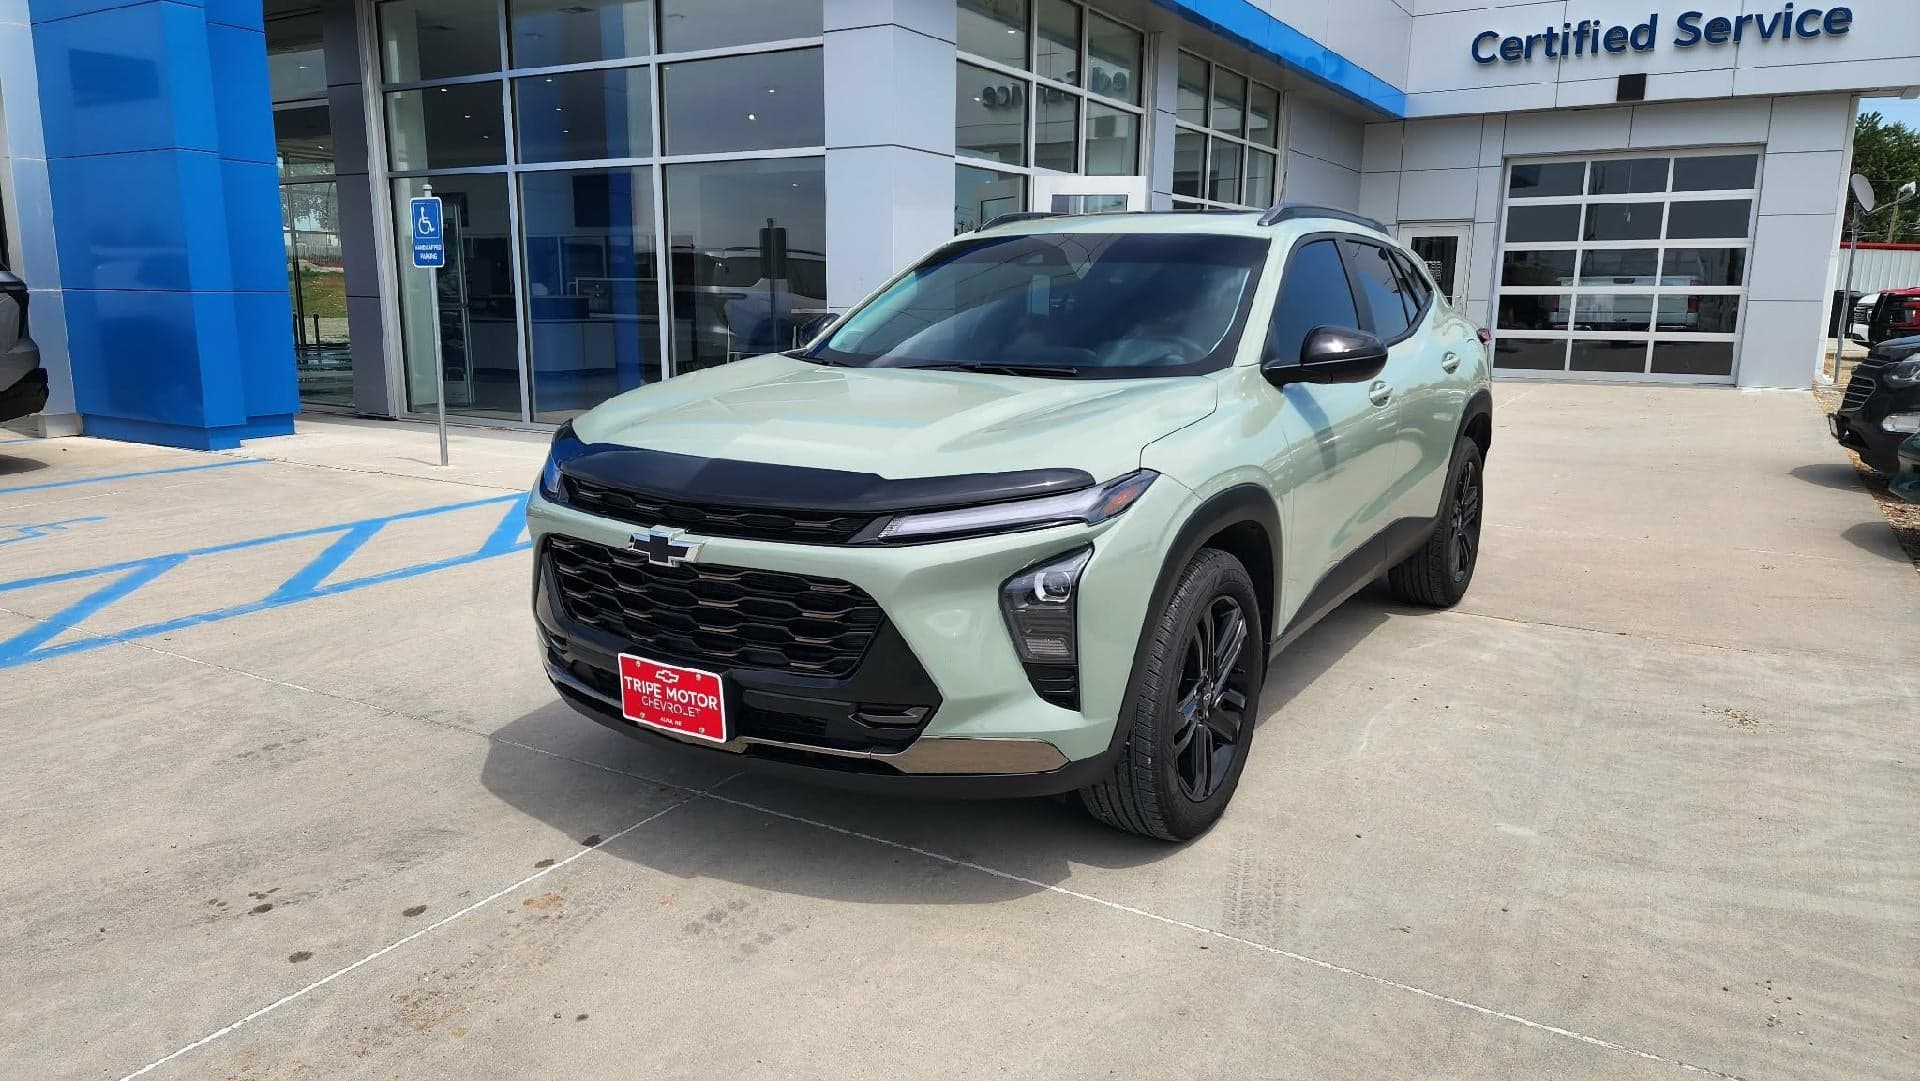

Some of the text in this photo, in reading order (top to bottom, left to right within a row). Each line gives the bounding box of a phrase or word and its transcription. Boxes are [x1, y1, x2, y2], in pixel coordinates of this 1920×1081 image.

[1471, 2, 1853, 65] Certified Service
[624, 676, 718, 711] TRIPE MOTOR
[641, 696, 701, 717] CHEVROLET
